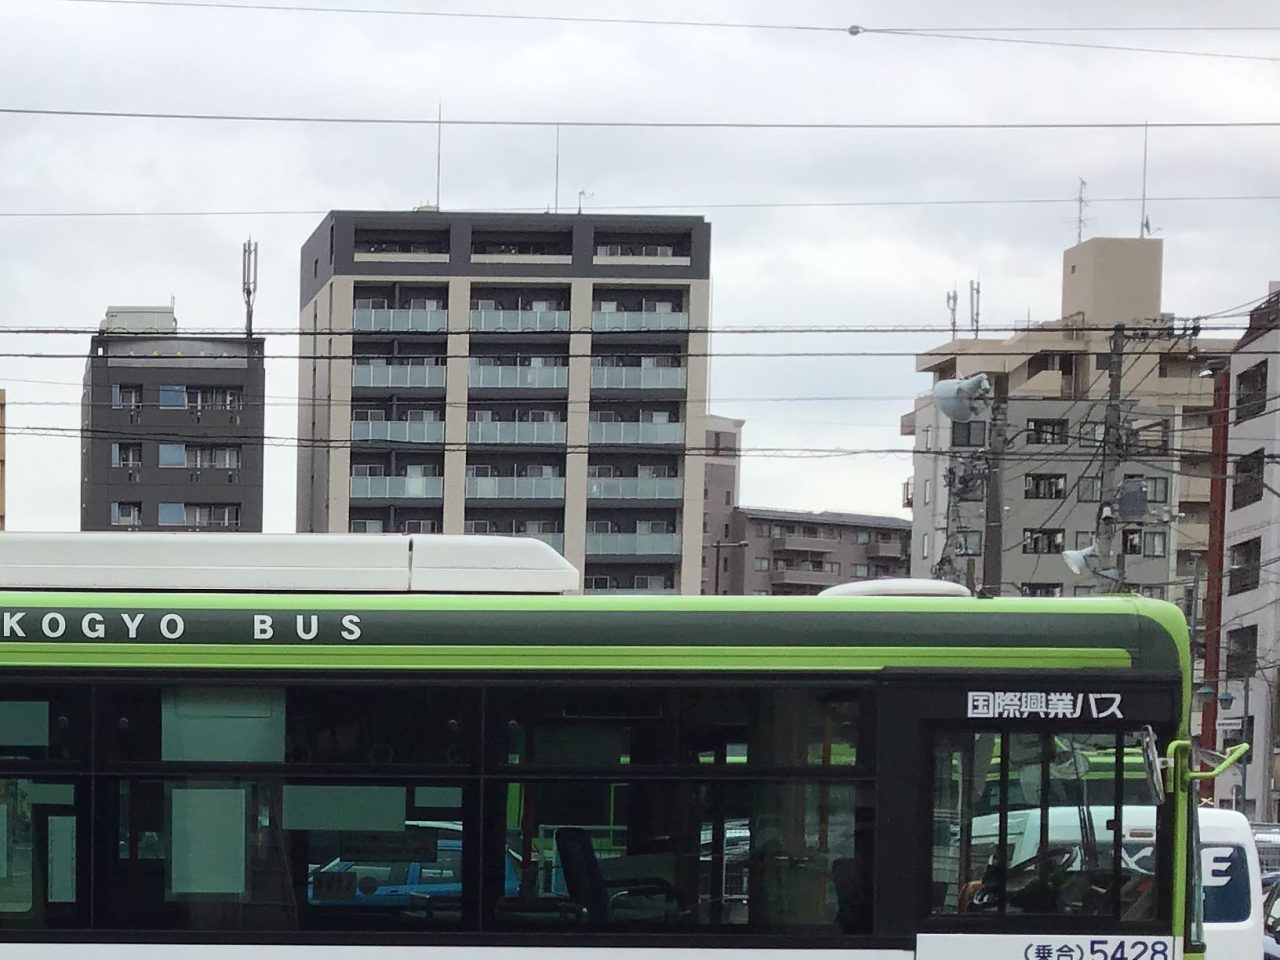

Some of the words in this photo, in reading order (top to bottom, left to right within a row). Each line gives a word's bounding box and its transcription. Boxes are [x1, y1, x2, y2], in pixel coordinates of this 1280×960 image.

[3, 611, 186, 640] KOGYO
[252, 613, 363, 641] BUS
[967, 691, 1123, 719] 国際興業バス
